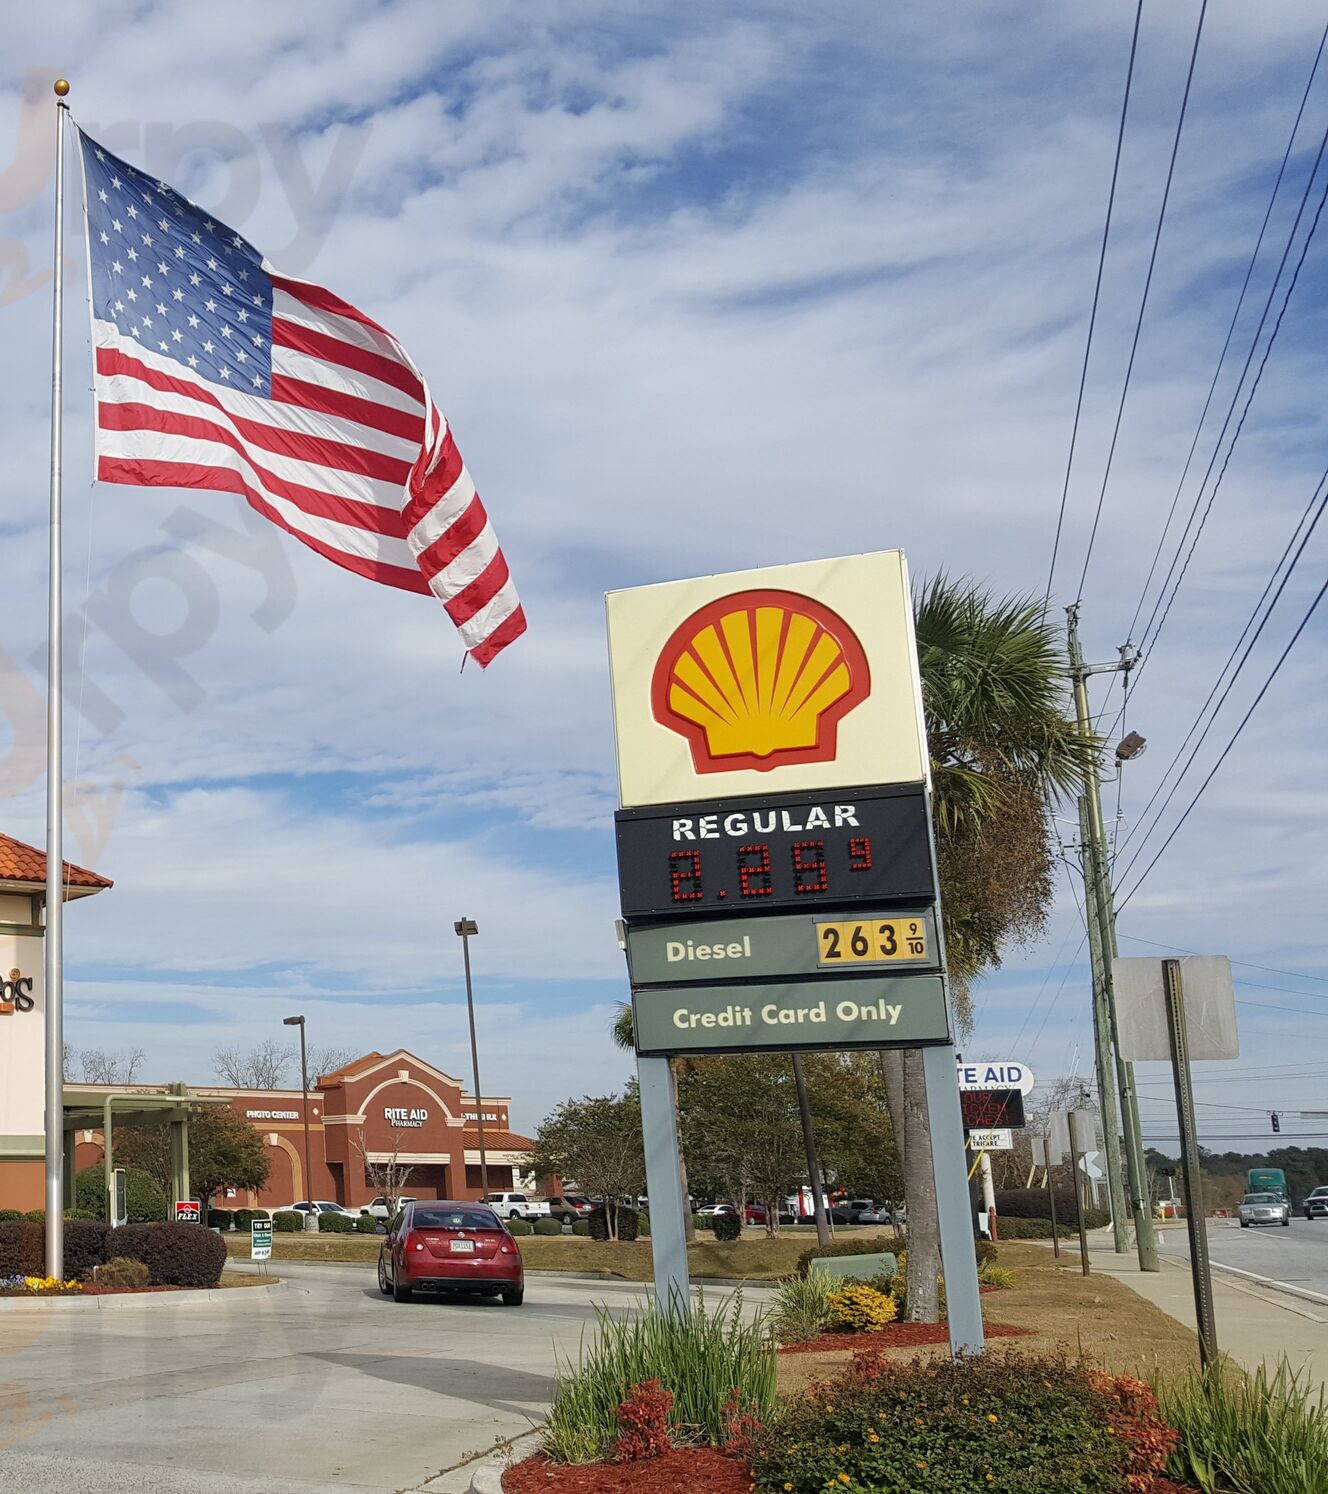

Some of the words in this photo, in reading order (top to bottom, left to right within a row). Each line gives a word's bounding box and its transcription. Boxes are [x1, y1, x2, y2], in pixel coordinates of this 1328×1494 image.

[672, 805, 860, 841] REGULAR
[666, 935, 752, 962] Diesel
[822, 924, 898, 959] 263
[673, 1005, 752, 1029] Credit
[761, 1001, 827, 1025] Card
[836, 998, 903, 1025] Only
[984, 1066, 1022, 1083] AID
[246, 1110, 271, 1119] PHOTO
[271, 1110, 299, 1120] CENTER
[384, 1107, 408, 1120] RITE
[409, 1108, 428, 1121] AID
